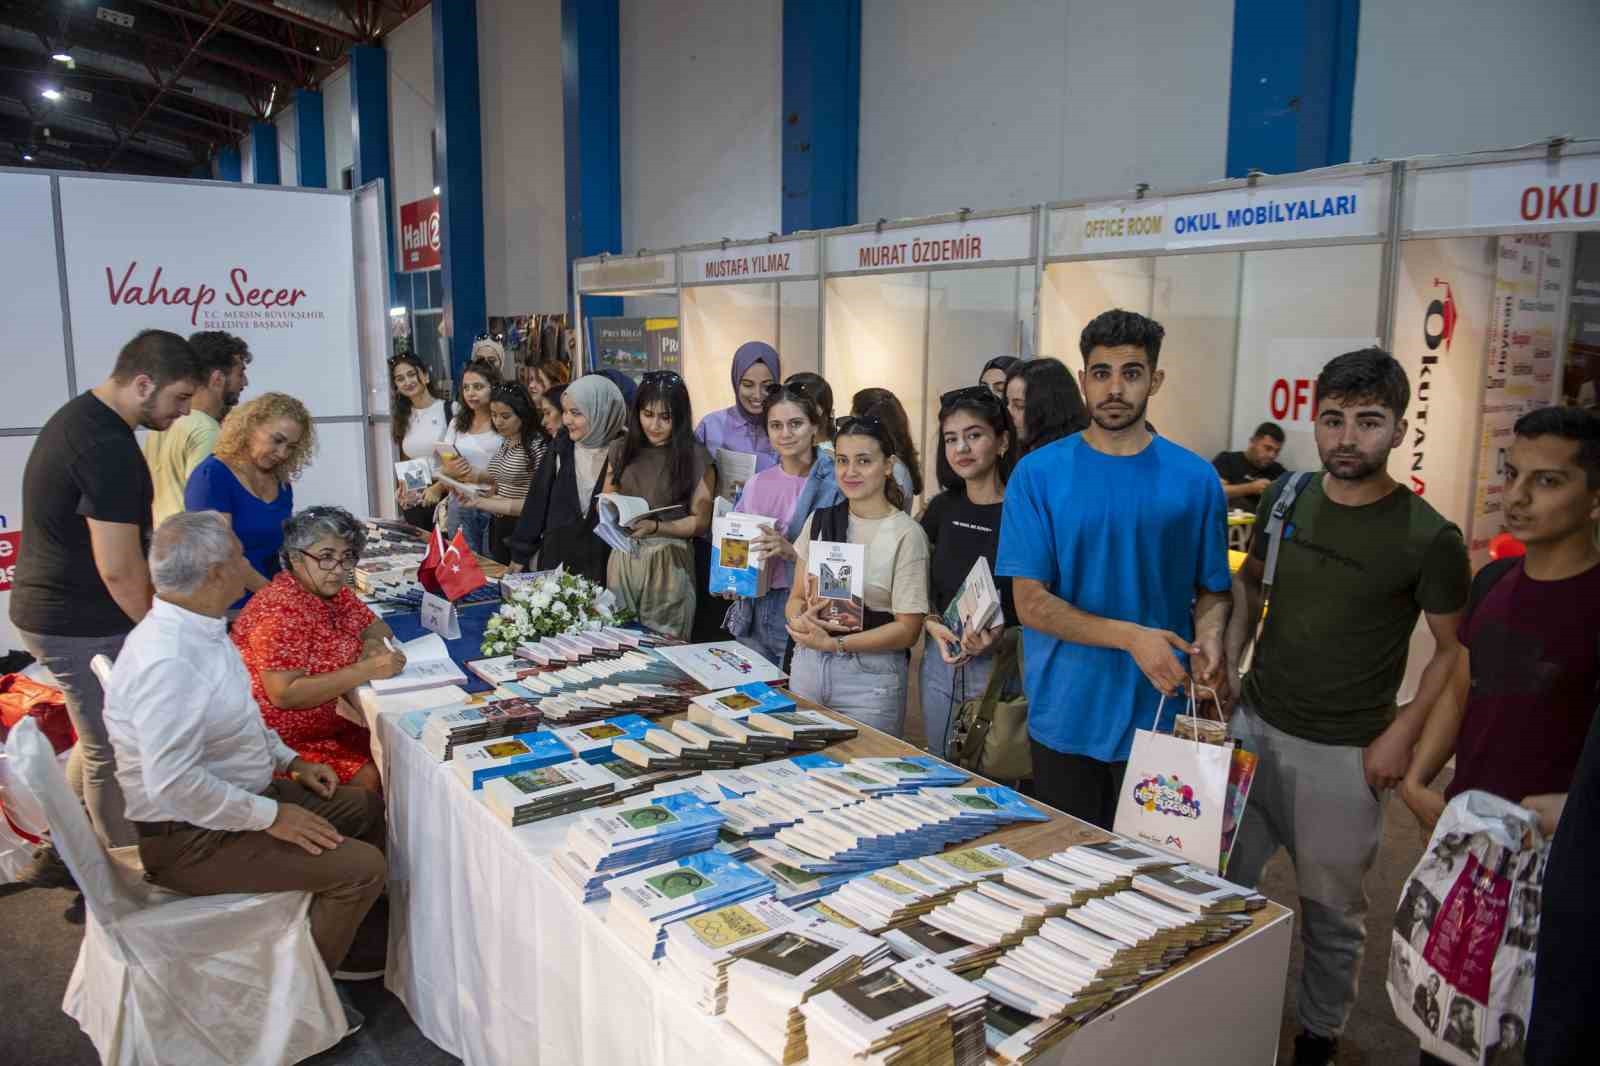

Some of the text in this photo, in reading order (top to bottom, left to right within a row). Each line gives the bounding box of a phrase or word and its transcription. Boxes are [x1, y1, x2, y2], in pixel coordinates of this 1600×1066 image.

[1085, 215, 1163, 238] OFFICE ROOM
[1174, 194, 1357, 235] OKUL MOBİLYALARI
[403, 220, 428, 250] Hall
[859, 234, 982, 267] MURAT ÖZDEMİR
[705, 253, 791, 278] MUSTAFA YILMAZ
[106, 262, 306, 325] Vahap Seçer
